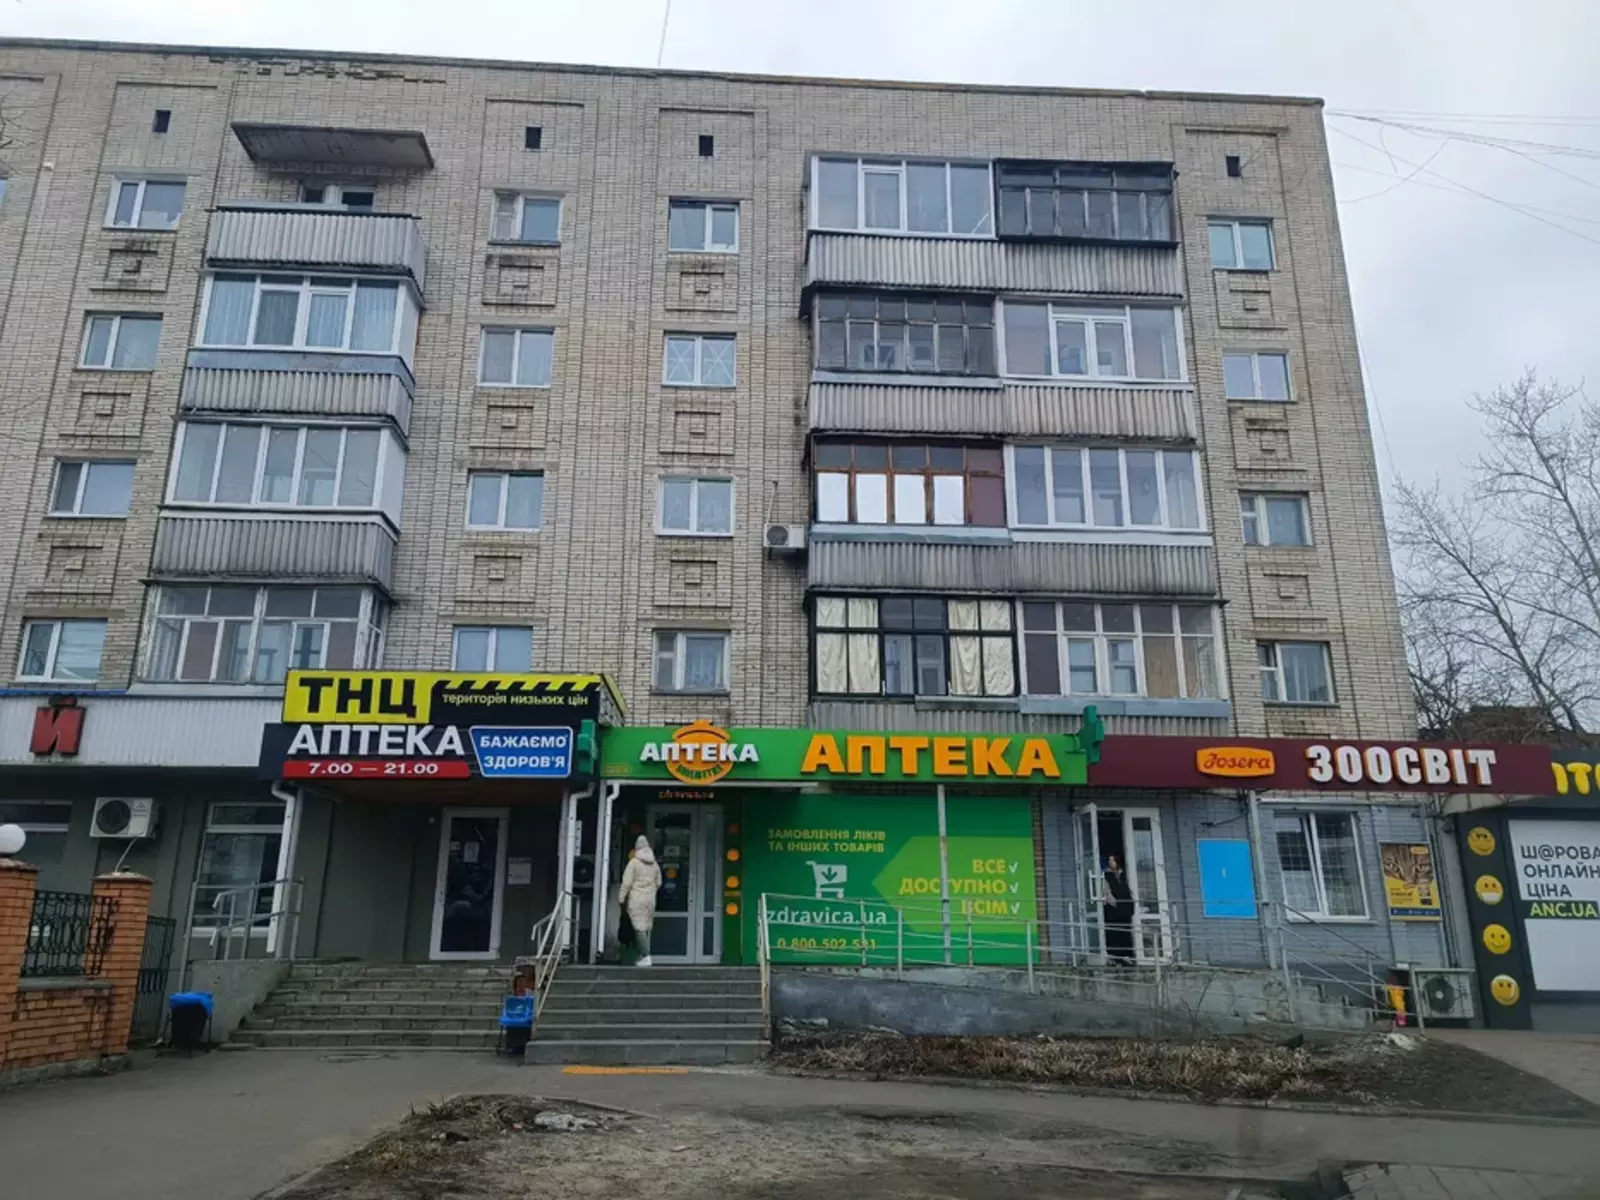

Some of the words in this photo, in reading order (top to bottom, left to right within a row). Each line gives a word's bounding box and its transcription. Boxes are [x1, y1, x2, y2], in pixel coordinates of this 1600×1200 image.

[299, 677, 417, 719] ТНЦ
[442, 691, 507, 706] територія
[510, 693, 564, 706] низьких
[568, 694, 589, 706] цін
[286, 724, 465, 756] АПТЕКА
[480, 735, 567, 749] БАЖАЄМО
[639, 742, 760, 762] АПТЕКА
[800, 733, 1061, 778] АПТЕКА
[1202, 751, 1272, 769] Josera
[309, 763, 353, 774] 7.00
[384, 763, 438, 774] 21.00
[484, 755, 566, 769] ЗДОРОВ'Я
[1305, 744, 1497, 786] ЗООСВІТ
[767, 828, 850, 840] ЗАМОВЛЕННЯ
[853, 830, 886, 841] ЛІКІВ
[768, 841, 784, 852] ТА
[787, 841, 830, 853] ІНШИХ
[834, 842, 885, 853] ТОВАРІВ
[972, 858, 1006, 874] ВСЕ
[900, 877, 1006, 896] ДОСУПНО
[1527, 883, 1573, 899] ЦІНА
[766, 906, 888, 925] zdravica.ua
[1530, 902, 1598, 917] ANC.UA
